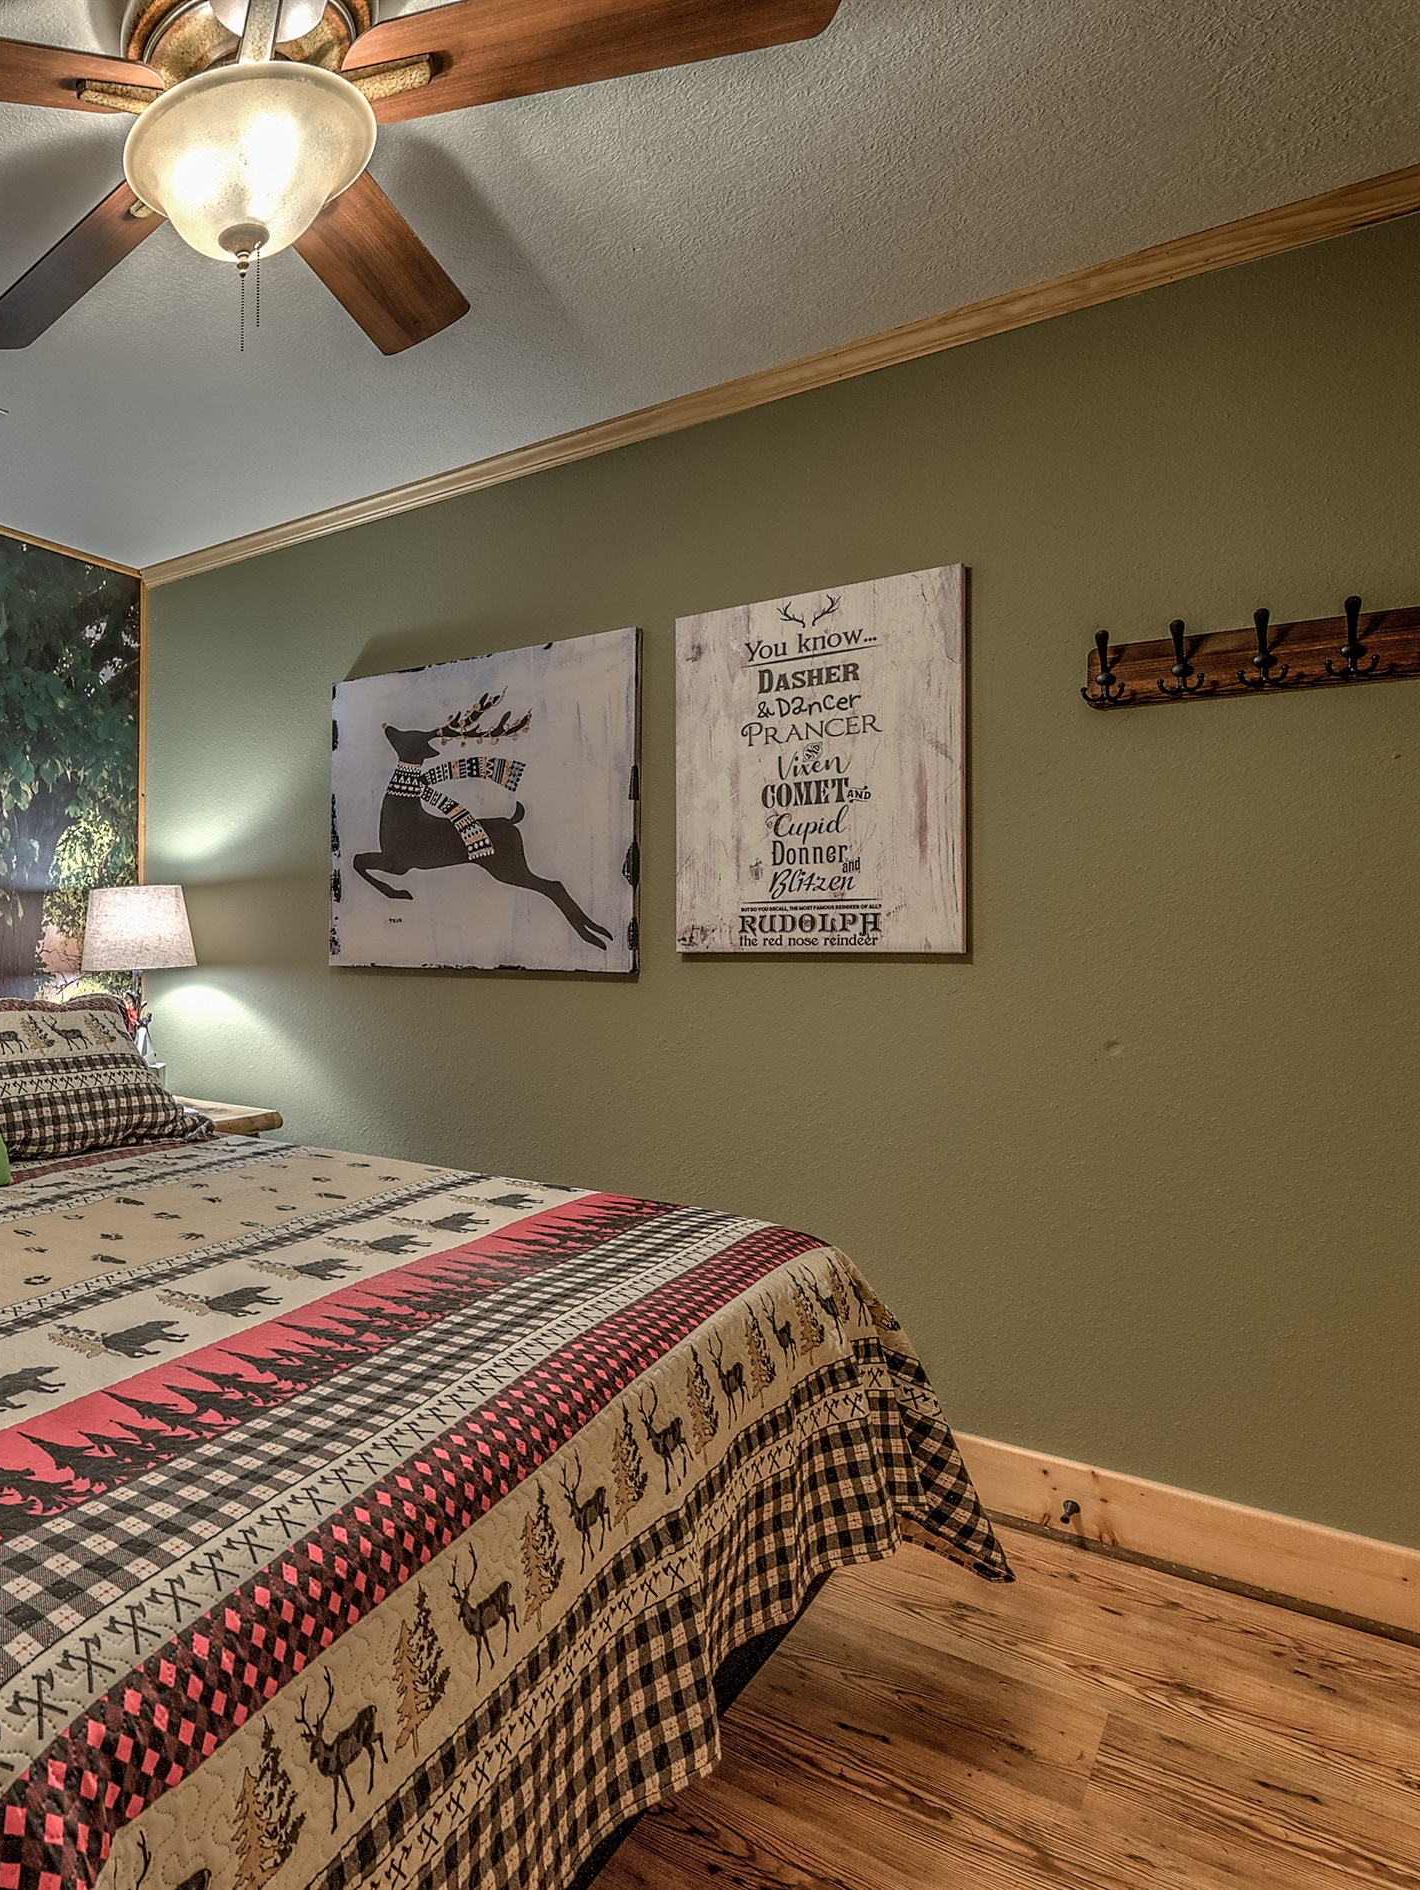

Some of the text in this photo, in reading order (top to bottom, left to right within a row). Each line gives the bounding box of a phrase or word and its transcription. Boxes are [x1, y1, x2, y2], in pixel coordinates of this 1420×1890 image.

[744, 628, 877, 662] You know...
[757, 662, 860, 695] DASHER
[757, 693, 862, 719] & Dancer
[741, 714, 883, 747] PRANCER
[778, 751, 851, 781] Vixen
[804, 743, 821, 760] AND
[761, 777, 872, 809] COMET AND
[765, 804, 849, 845] Cupid
[771, 840, 861, 874] Donner and
[768, 868, 856, 900] Blitzen
[738, 912, 882, 937] RUDOLPH
[739, 934, 878, 946] the red nose reindeer
